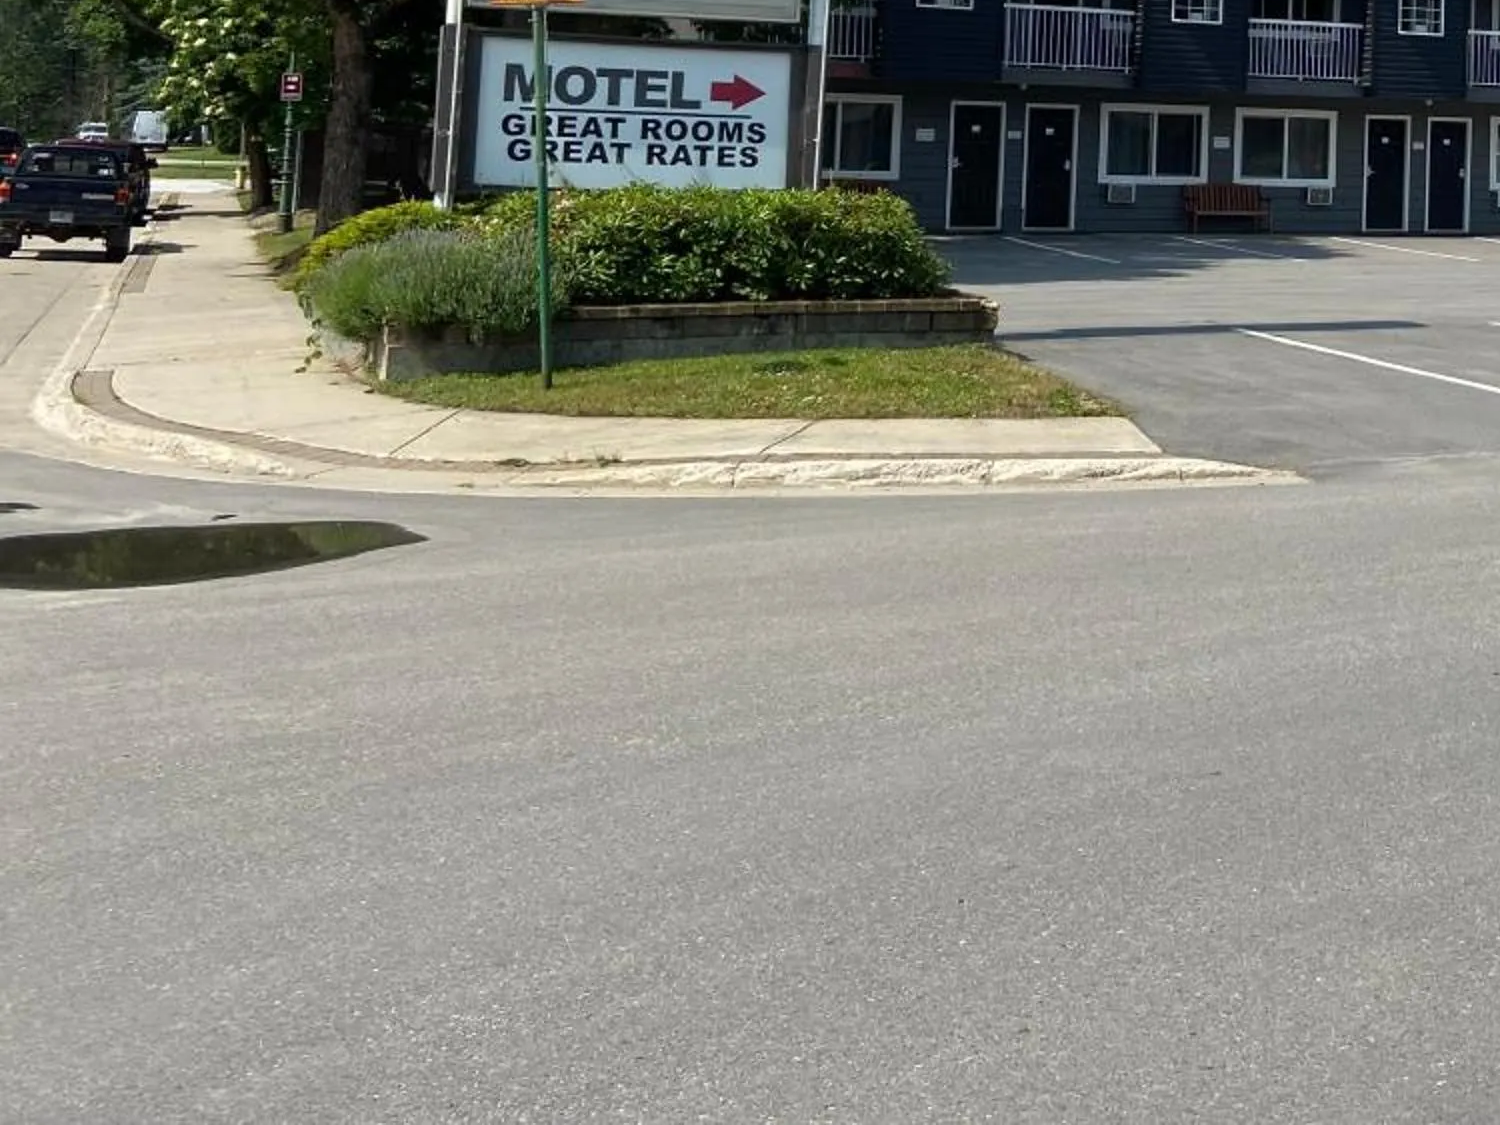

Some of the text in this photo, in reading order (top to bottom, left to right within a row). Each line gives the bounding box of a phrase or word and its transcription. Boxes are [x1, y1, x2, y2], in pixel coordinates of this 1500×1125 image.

[503, 62, 702, 110] MOTEL
[501, 113, 767, 144] GREAT ROOMS
[507, 138, 760, 168] GREAT RATES
